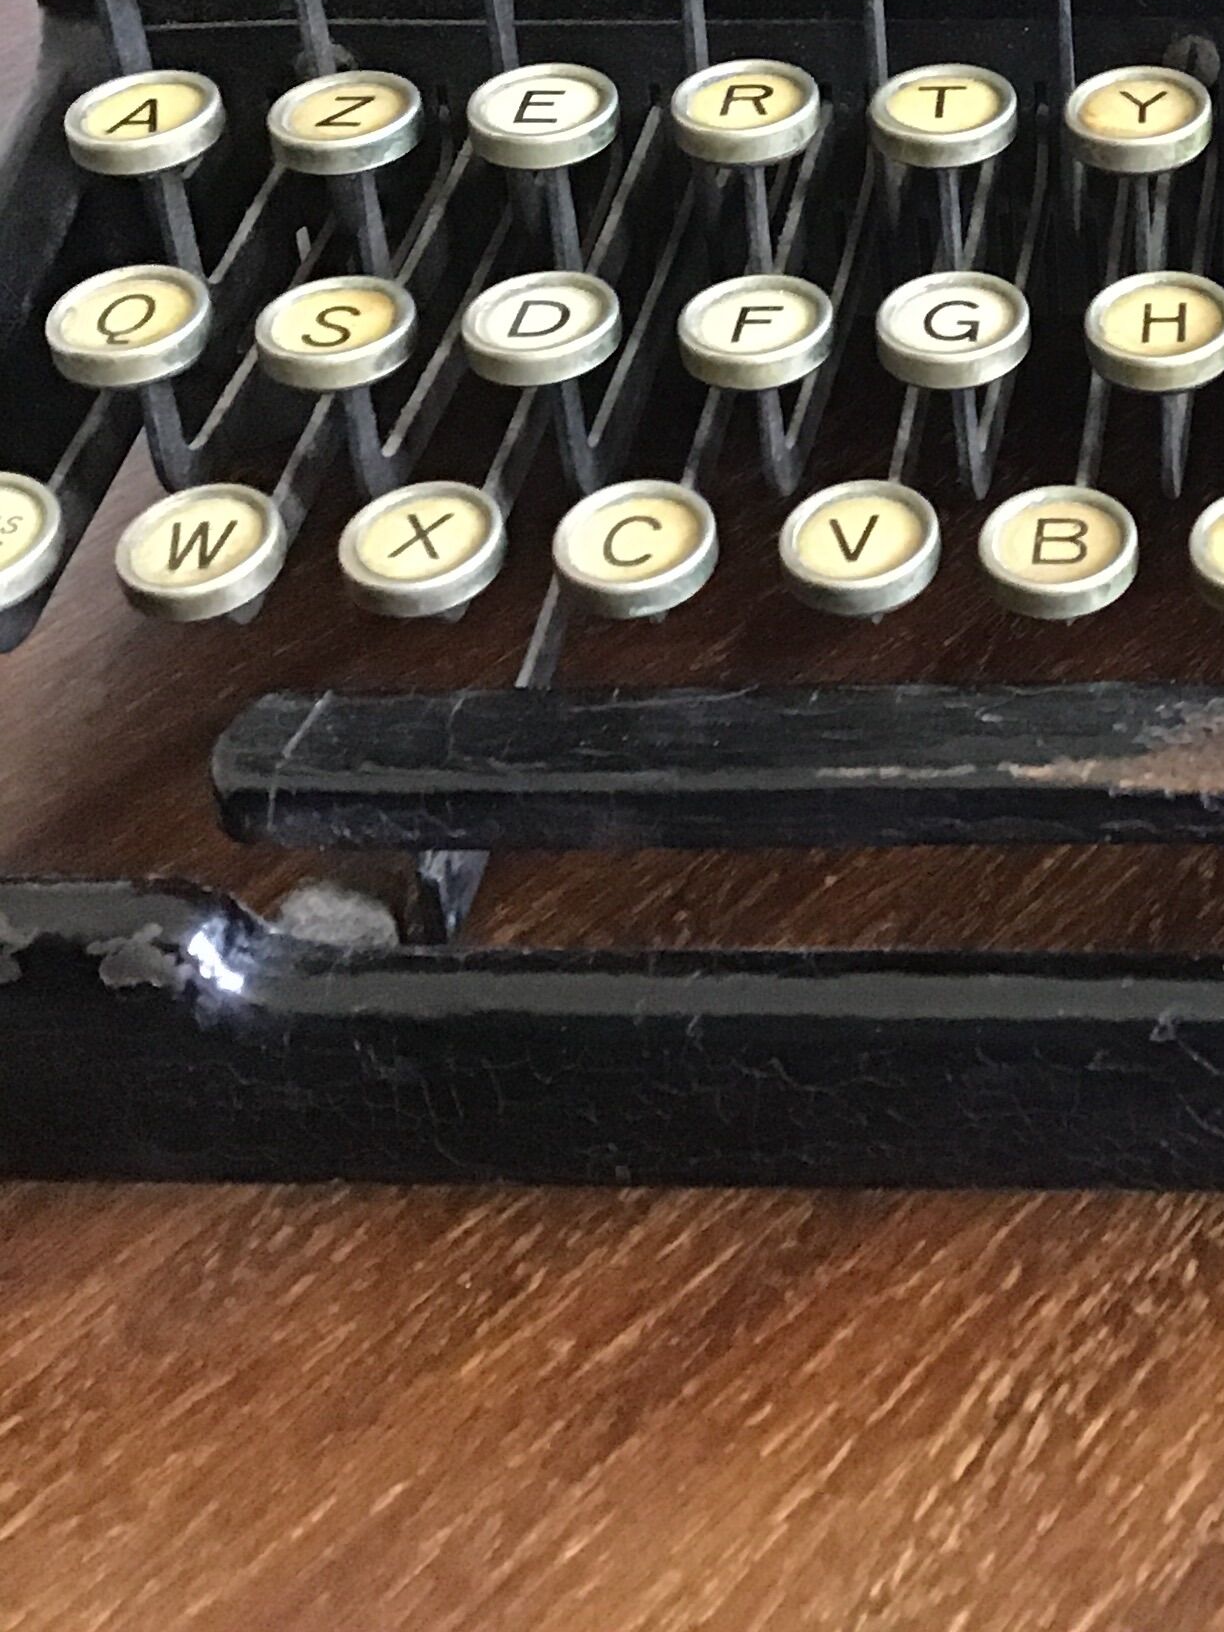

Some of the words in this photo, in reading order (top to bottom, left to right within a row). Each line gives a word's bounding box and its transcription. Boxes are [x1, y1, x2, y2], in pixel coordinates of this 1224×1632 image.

[105, 97, 158, 134] A
[314, 95, 376, 127] Z
[513, 90, 566, 124] E
[719, 84, 775, 116] R
[918, 85, 968, 119] T
[1119, 90, 1168, 124] Y
[97, 294, 157, 344] Q
[301, 305, 362, 347] S
[507, 300, 571, 338] D
[730, 305, 784, 343] F
[924, 301, 980, 342] G
[1141, 302, 1187, 343] H
[167, 520, 238, 571] W
[387, 512, 455, 560] X
[603, 515, 662, 567] C
[828, 514, 879, 562] V
[1031, 517, 1089, 565] B
